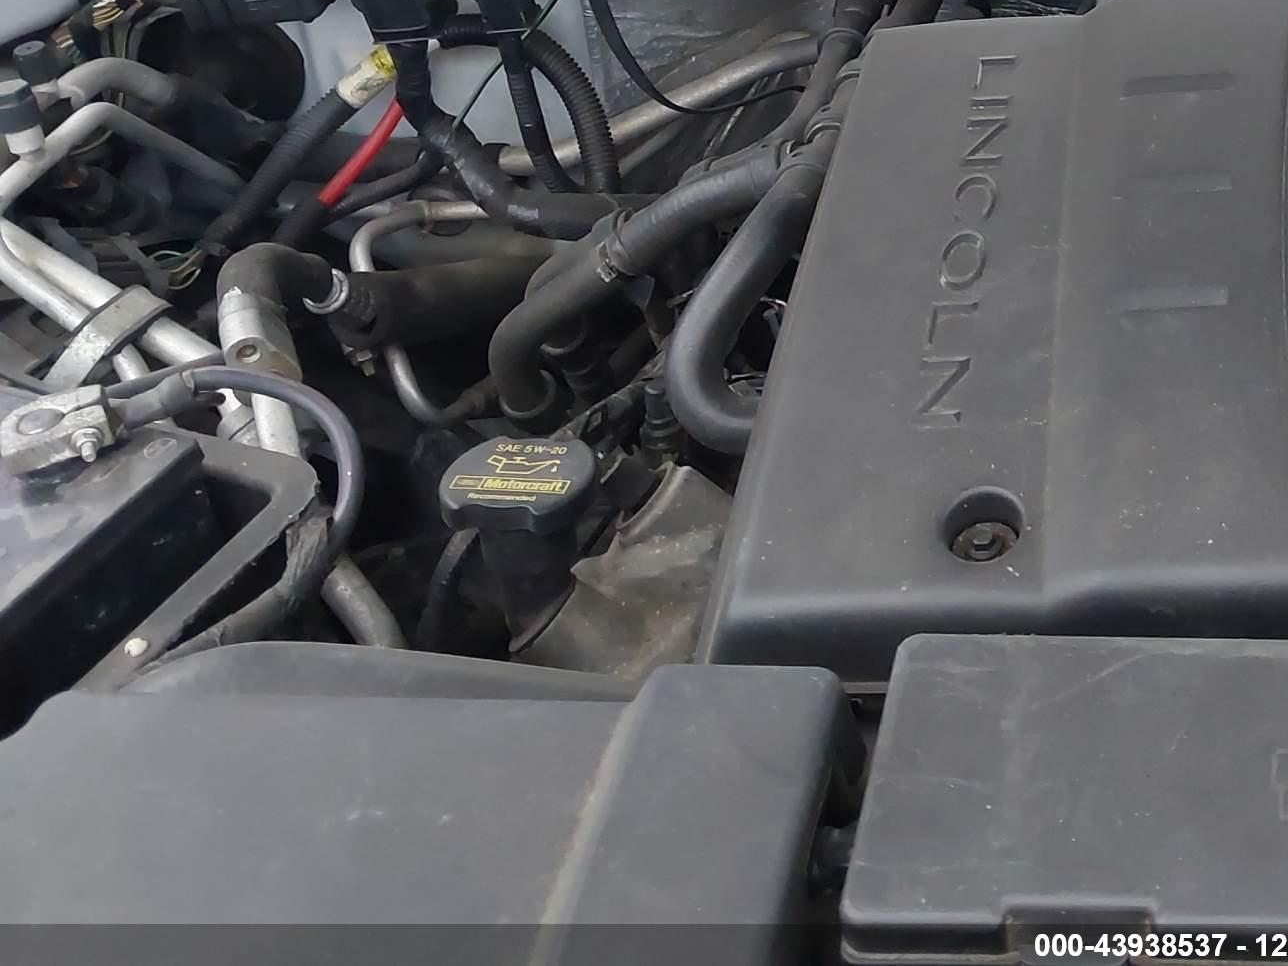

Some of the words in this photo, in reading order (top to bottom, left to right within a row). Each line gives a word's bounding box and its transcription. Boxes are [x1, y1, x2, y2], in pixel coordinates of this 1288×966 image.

[914, 54, 1018, 426] LINCOLN
[495, 444, 523, 453] SAE
[524, 444, 568, 455] 5W-20
[483, 478, 562, 492] Motorcraft
